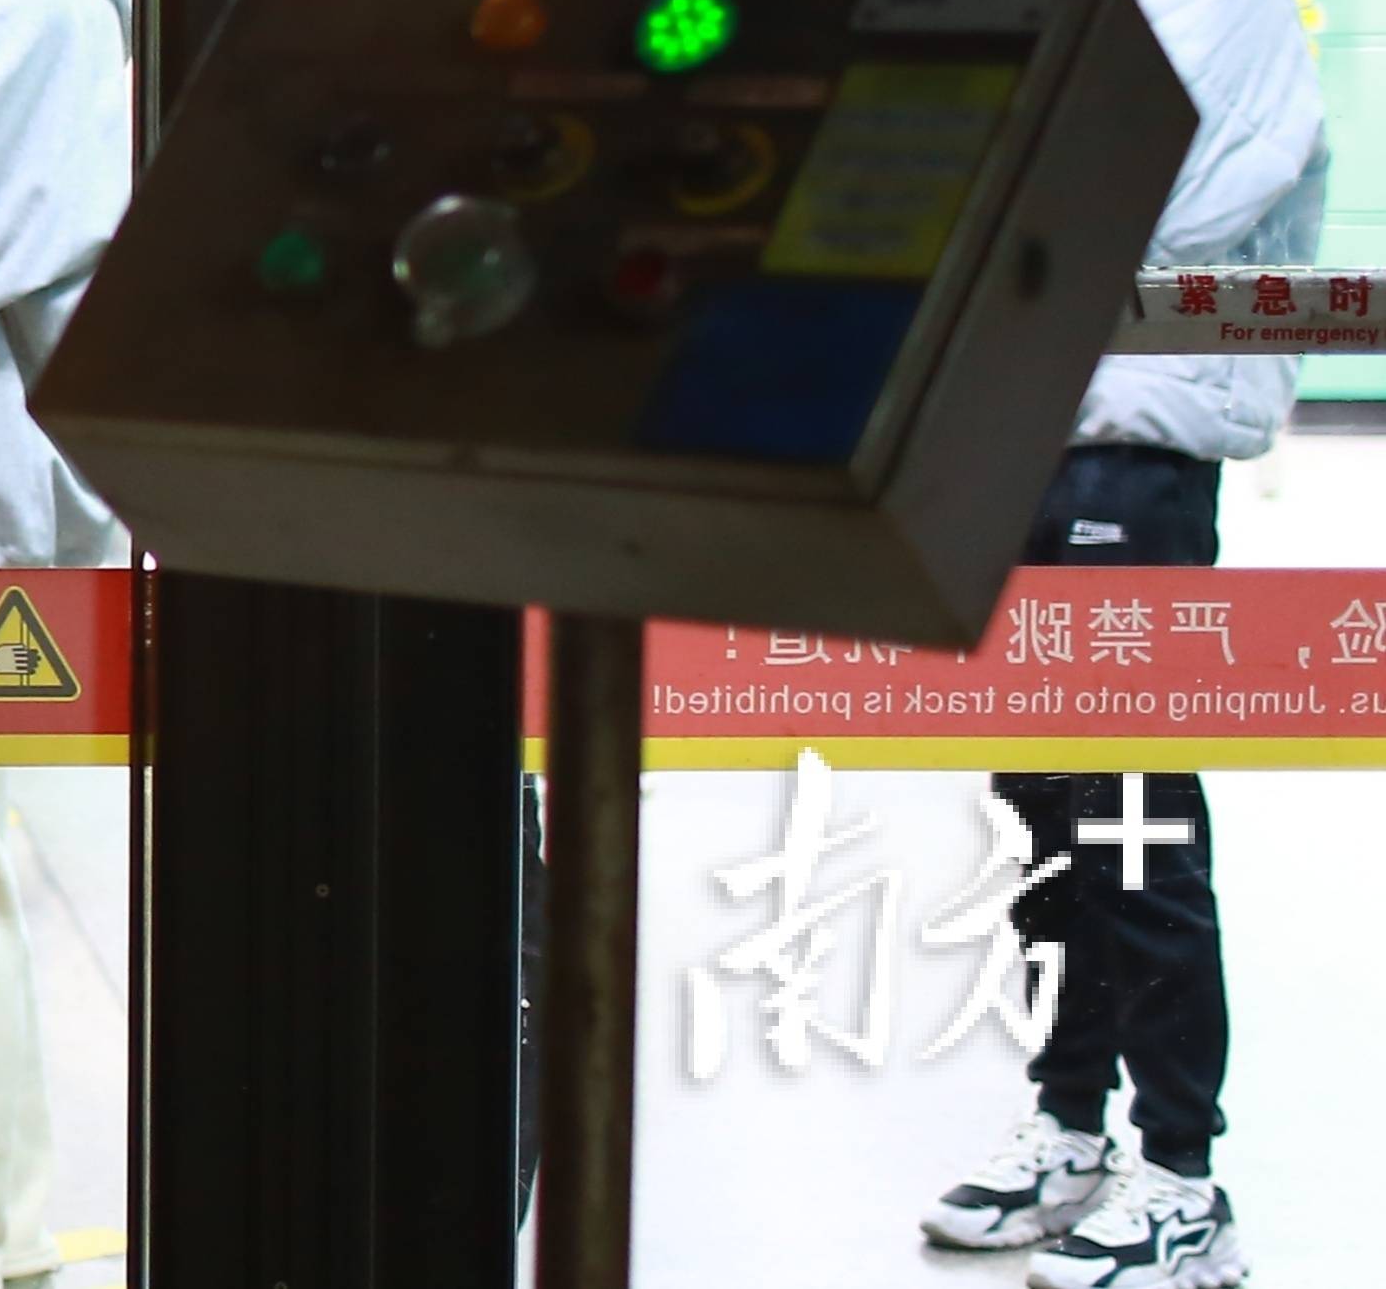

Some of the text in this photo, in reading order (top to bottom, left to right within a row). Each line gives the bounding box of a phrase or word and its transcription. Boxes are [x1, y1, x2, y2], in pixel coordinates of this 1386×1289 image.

[1177, 274, 1373, 317] 紧急时
[1220, 322, 1378, 345] For emergency
